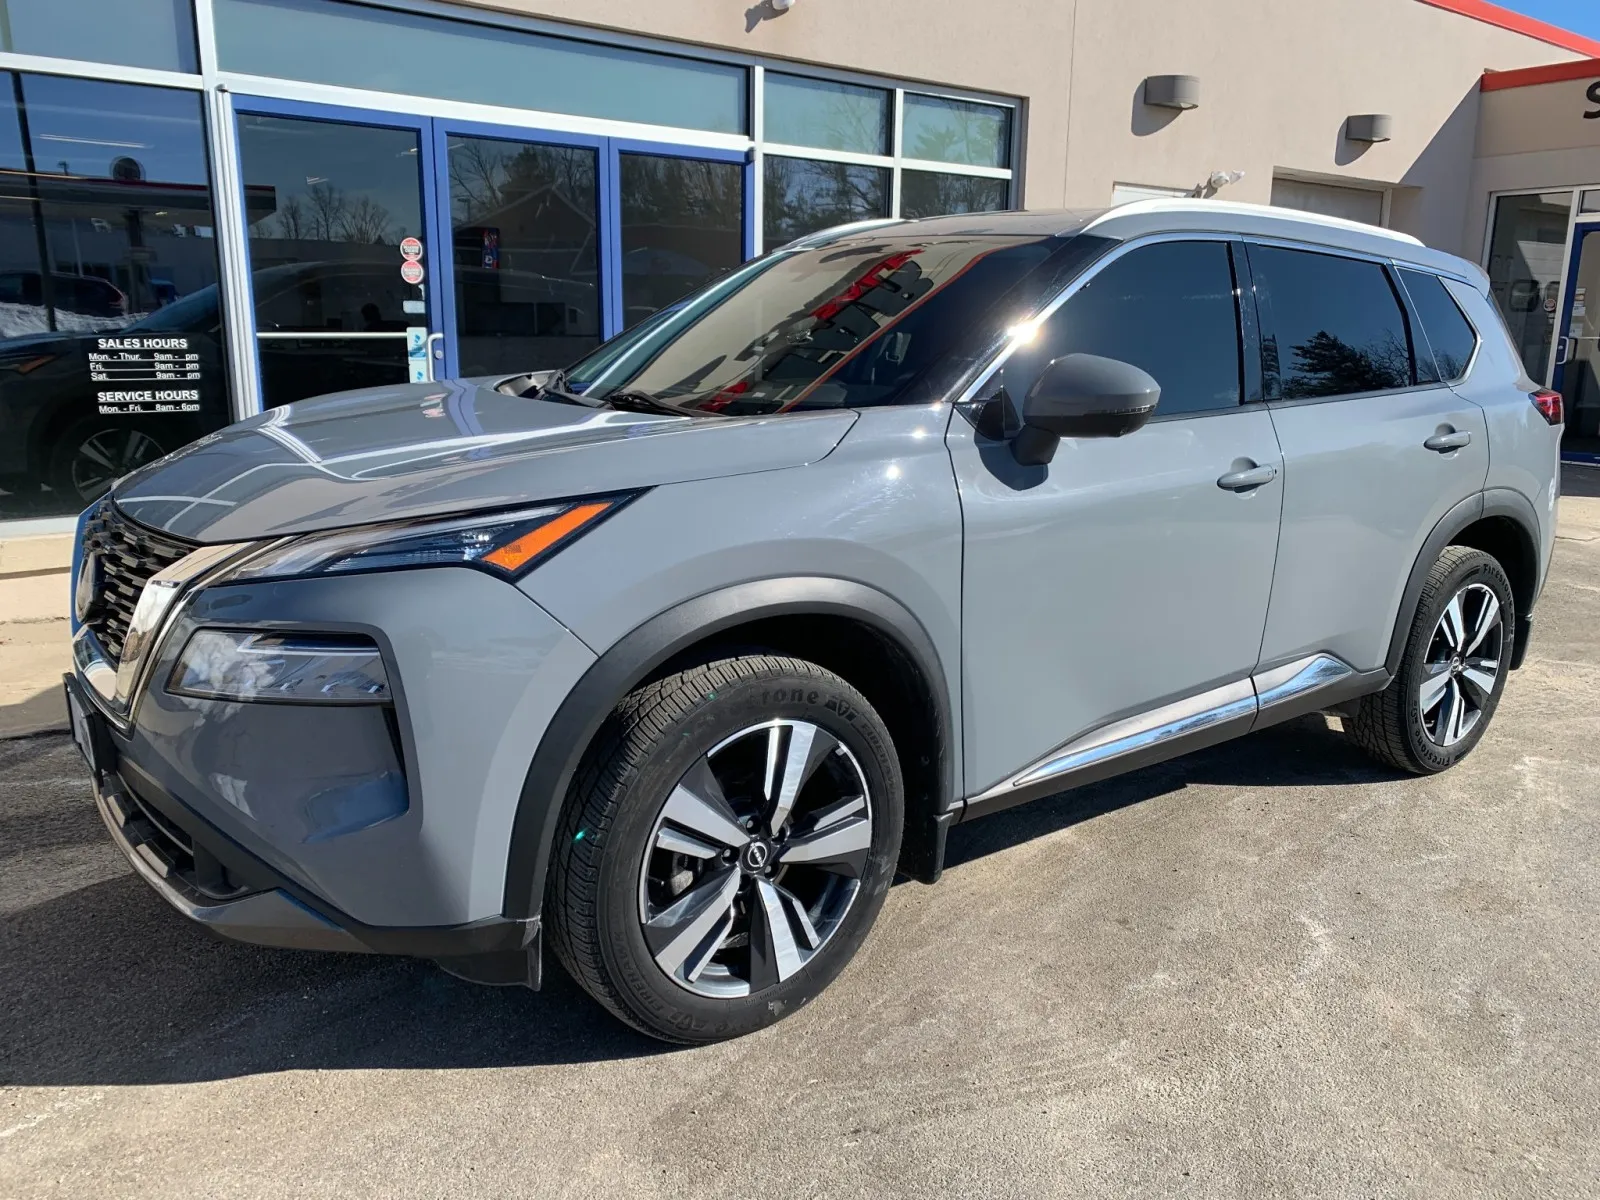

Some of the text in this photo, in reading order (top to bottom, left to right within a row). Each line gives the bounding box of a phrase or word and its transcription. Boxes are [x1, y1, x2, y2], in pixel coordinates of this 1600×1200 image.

[98, 338, 188, 348] SALES HOURS
[118, 352, 141, 360] Thur.
[185, 353, 199, 361] pm
[90, 362, 105, 370] Fri.
[91, 372, 109, 380] Sat.
[187, 372, 200, 380] pm
[97, 390, 198, 401] SERVICE HOURS
[99, 405, 121, 413] Mon.
[129, 404, 143, 412] Fri.
[181, 403, 200, 411] 6pm
[1482, 563, 1513, 609] Firestone
[1415, 729, 1450, 767] Firestone
